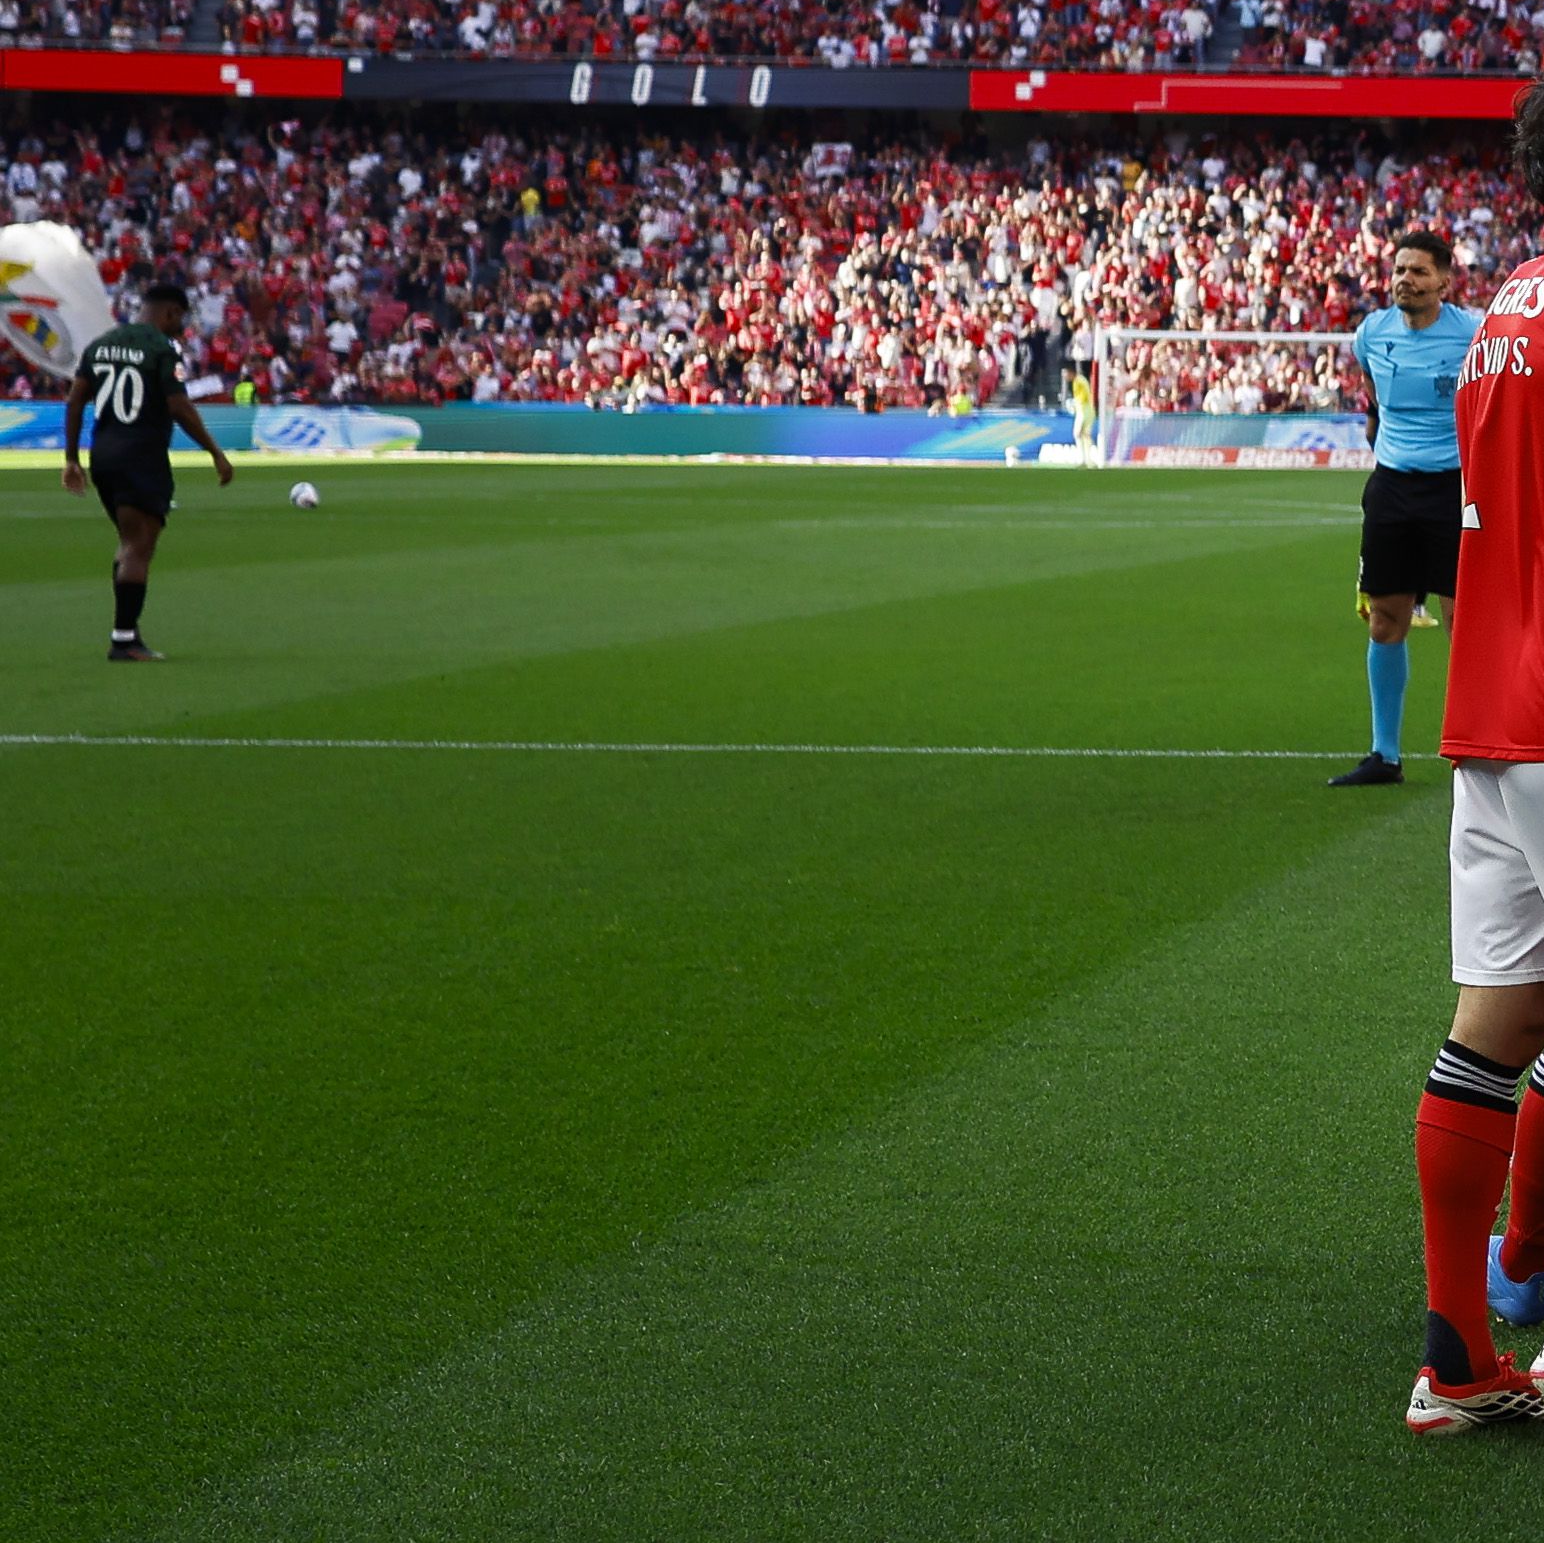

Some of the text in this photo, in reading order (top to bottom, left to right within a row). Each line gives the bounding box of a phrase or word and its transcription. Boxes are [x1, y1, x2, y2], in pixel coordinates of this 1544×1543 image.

[570, 62, 771, 107] GOLO
[1511, 336, 1533, 377] S.
[92, 362, 144, 424] 70
